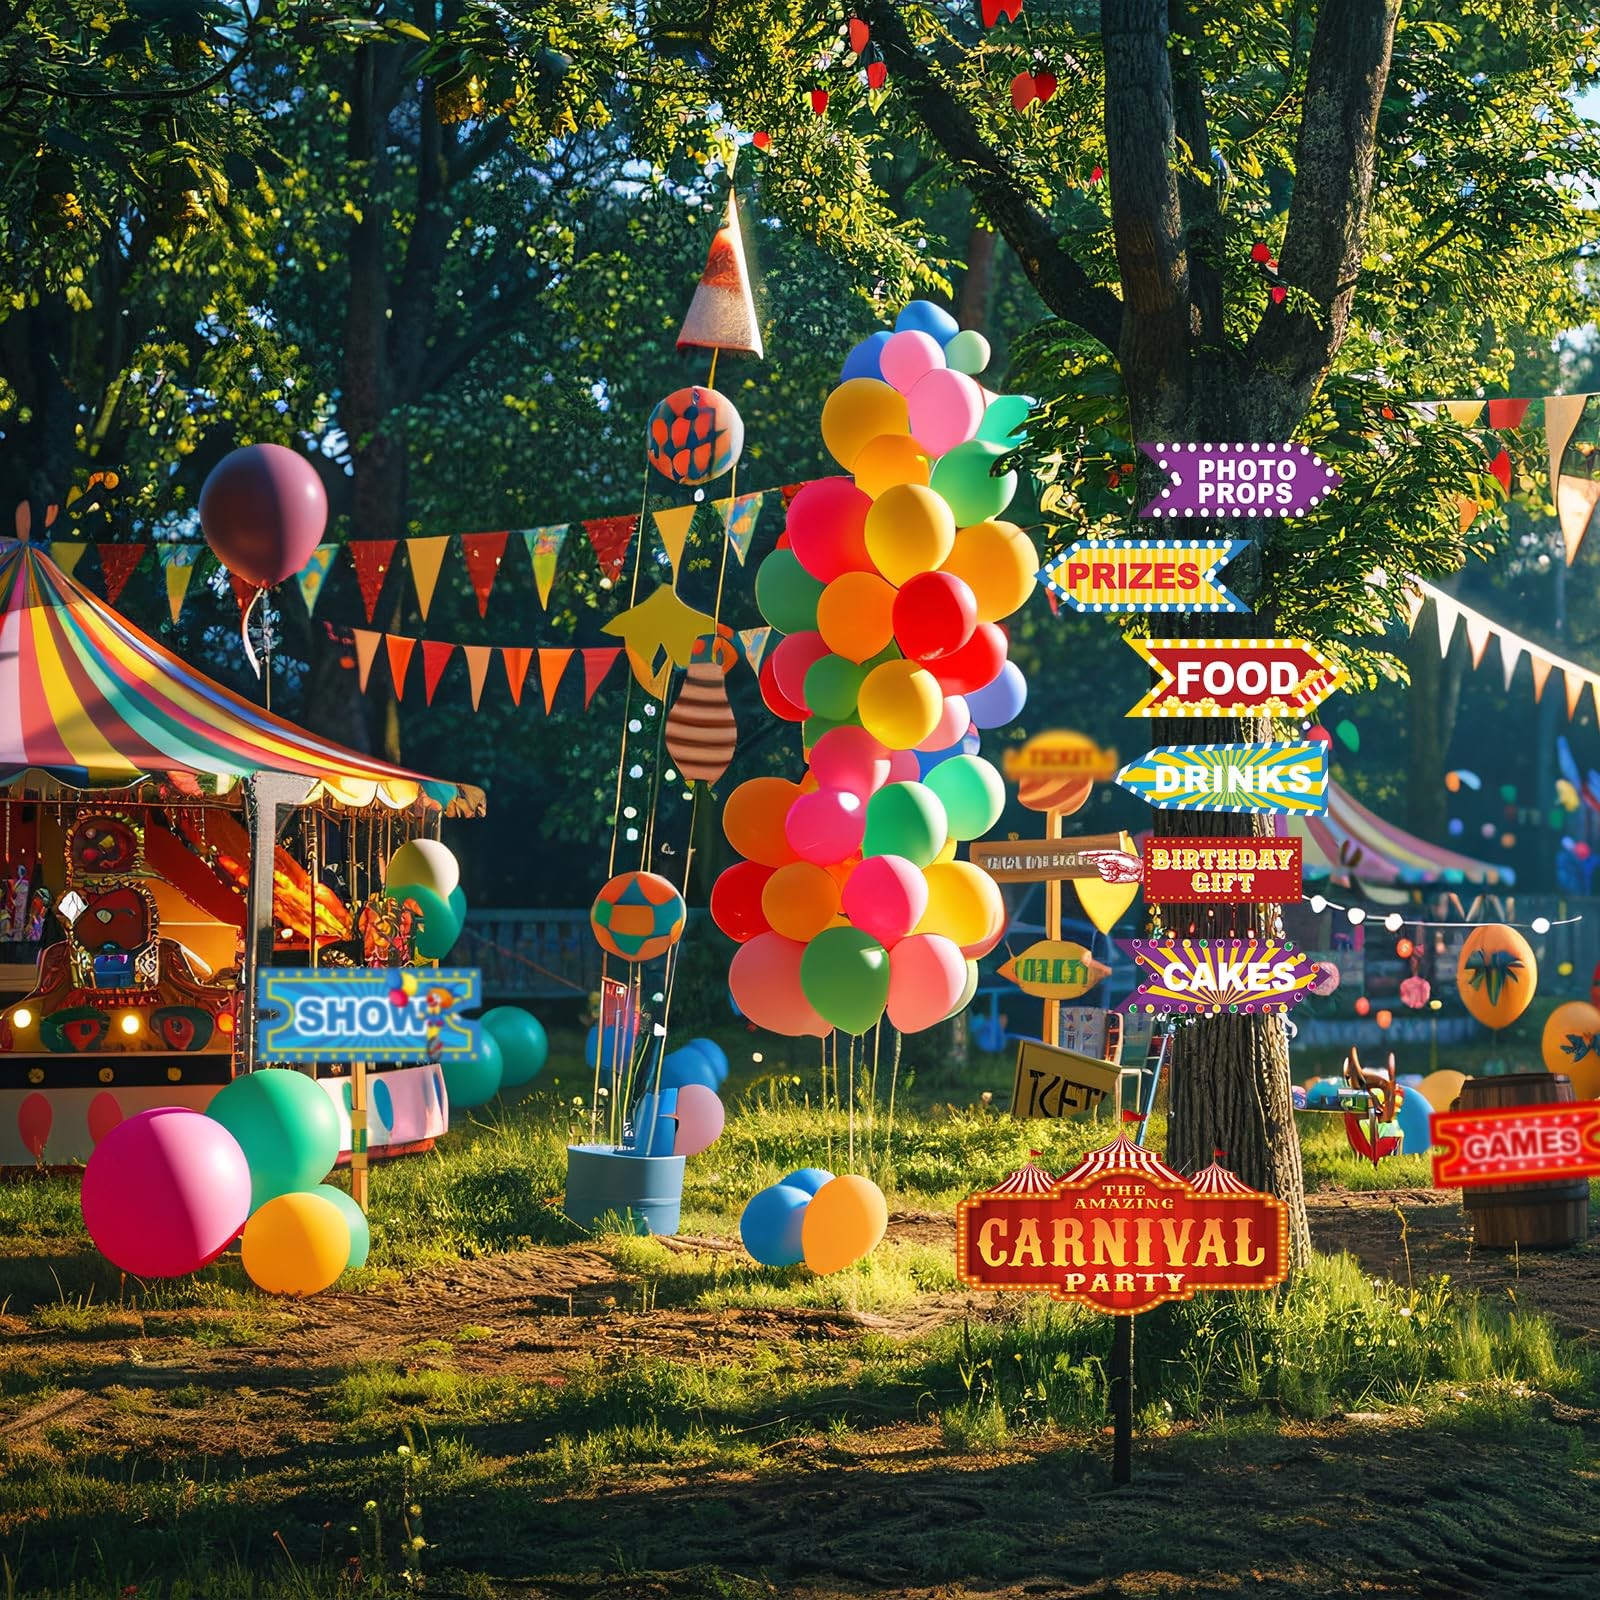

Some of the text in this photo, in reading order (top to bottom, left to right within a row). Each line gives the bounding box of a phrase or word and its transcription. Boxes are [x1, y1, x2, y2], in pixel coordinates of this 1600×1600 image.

[1198, 459, 1297, 481] PHOTO
[1198, 482, 1293, 504] PROPS
[1068, 562, 1200, 590] PRIZES
[1177, 660, 1299, 695] FOOD
[1155, 765, 1312, 794] DRINKS
[1151, 849, 1293, 870] BIRTHDAY
[1191, 873, 1255, 893] GIFT
[1163, 962, 1296, 991] CAKES
[294, 995, 429, 1036] SHOW
[1464, 1127, 1579, 1163] GAMES
[1102, 1185, 1146, 1196] THE
[1074, 1198, 1175, 1210] AMAZING
[976, 1217, 1265, 1267] CARNIVAL
[1064, 1273, 1186, 1292] PARTY
